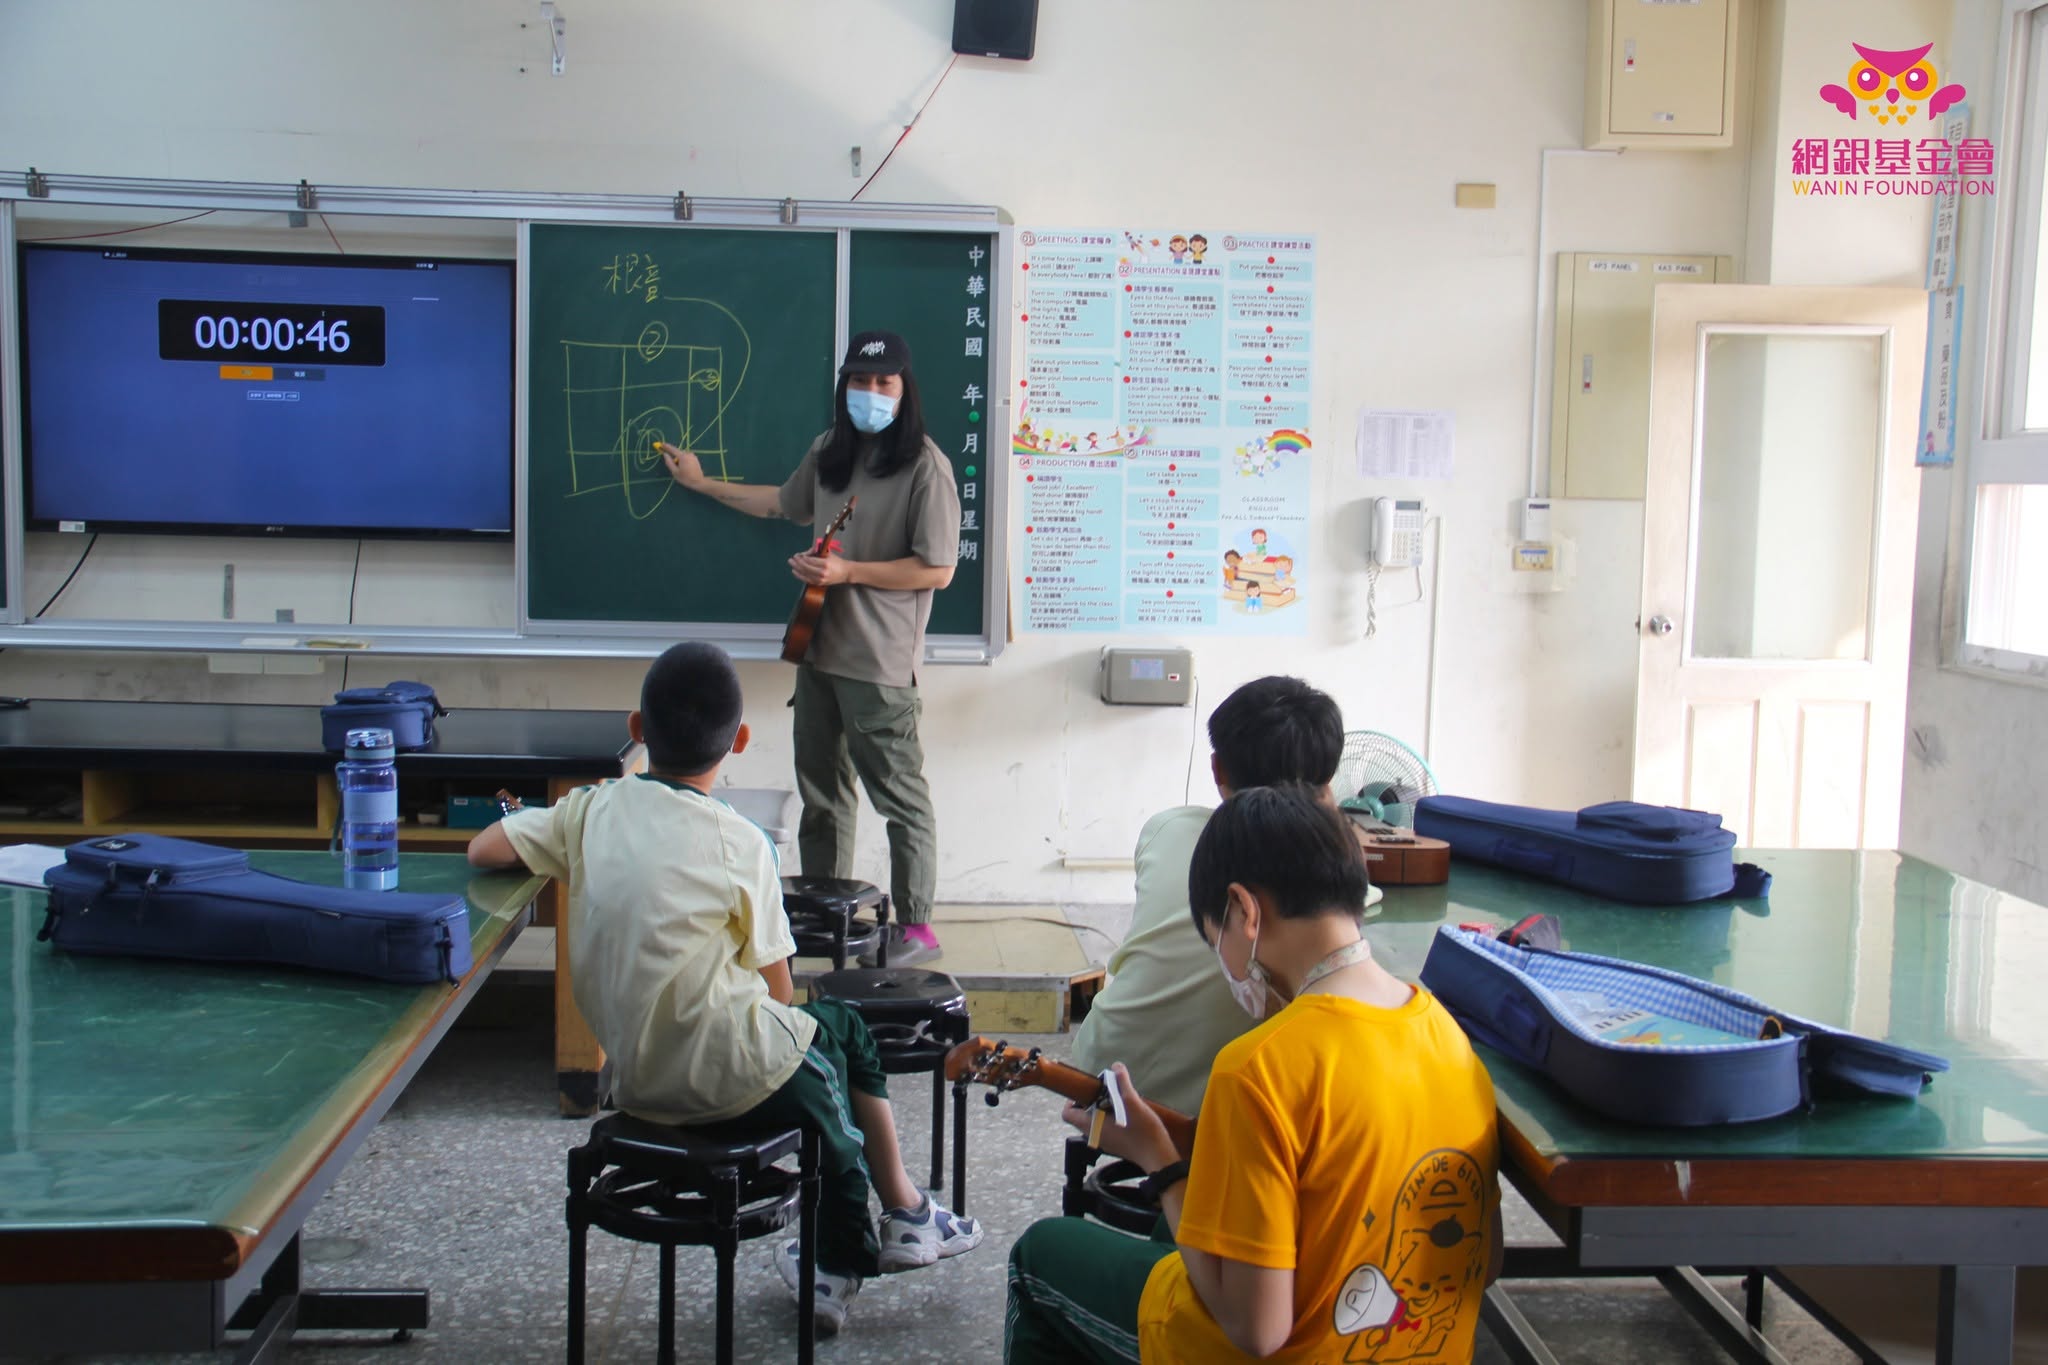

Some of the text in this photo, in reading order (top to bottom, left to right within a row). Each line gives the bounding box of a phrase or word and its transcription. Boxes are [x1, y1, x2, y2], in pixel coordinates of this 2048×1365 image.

[965, 245, 986, 357] 中華民國
[194, 315, 351, 353] 00:00:46
[962, 384, 984, 404] 年
[962, 432, 978, 454] 月
[1401, 1155, 1449, 1210] JIN-DE
